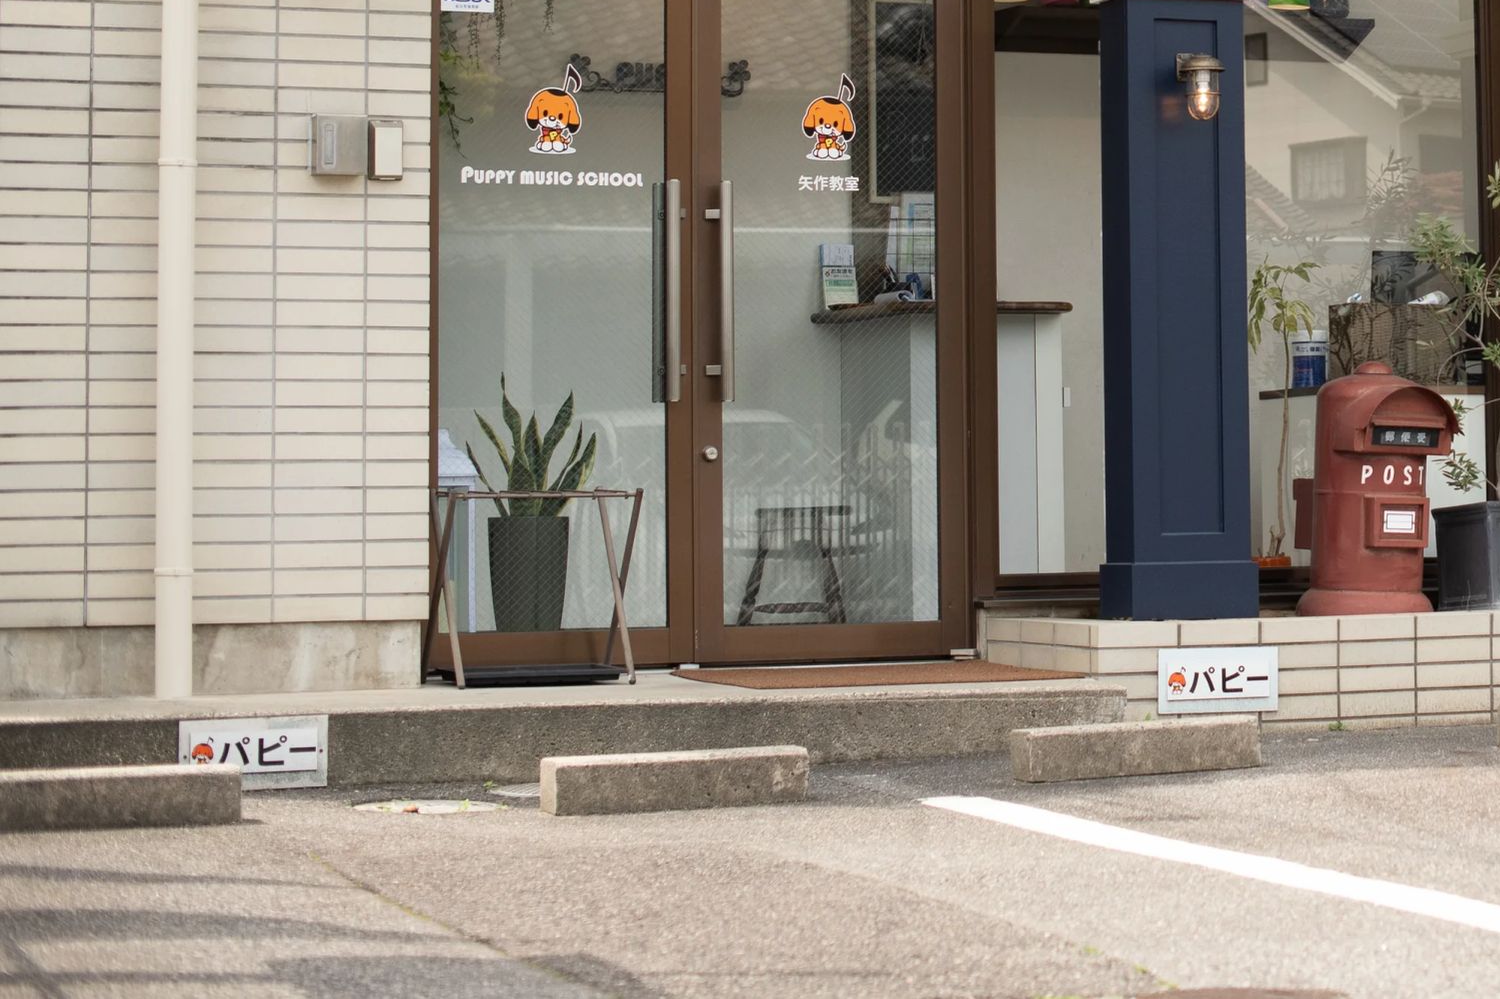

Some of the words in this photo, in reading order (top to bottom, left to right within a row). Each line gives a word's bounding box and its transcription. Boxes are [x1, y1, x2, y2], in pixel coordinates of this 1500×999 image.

[798, 175, 860, 192] 矢作教室
[1361, 464, 1425, 485] POST
[1189, 665, 1269, 694] パピー
[219, 735, 317, 766] パピー
